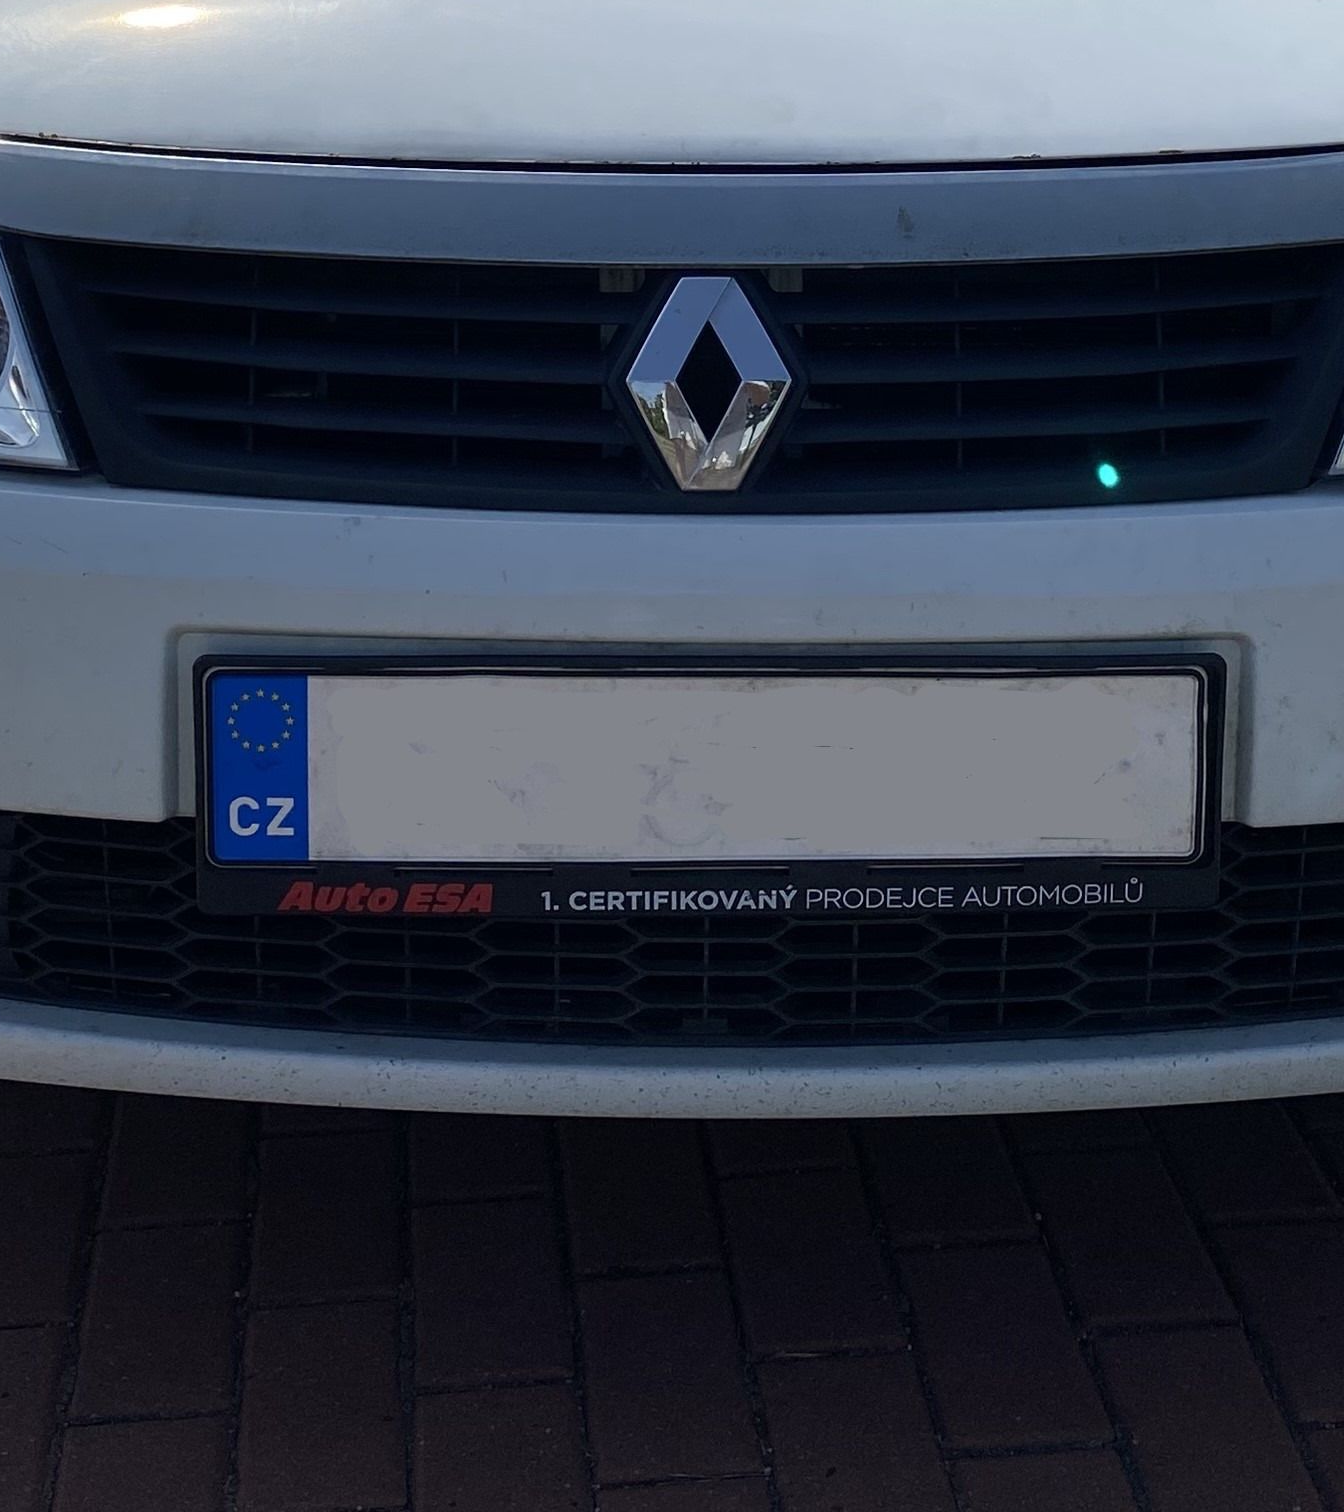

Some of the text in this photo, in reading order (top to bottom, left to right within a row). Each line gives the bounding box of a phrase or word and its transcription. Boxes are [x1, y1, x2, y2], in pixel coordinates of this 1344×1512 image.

[229, 797, 295, 837] CZ
[276, 881, 494, 914] Auto ESA
[540, 876, 1144, 911] 1. CERTIFIKOVANÝ PRODEJCE AUTOMOBILŮ
